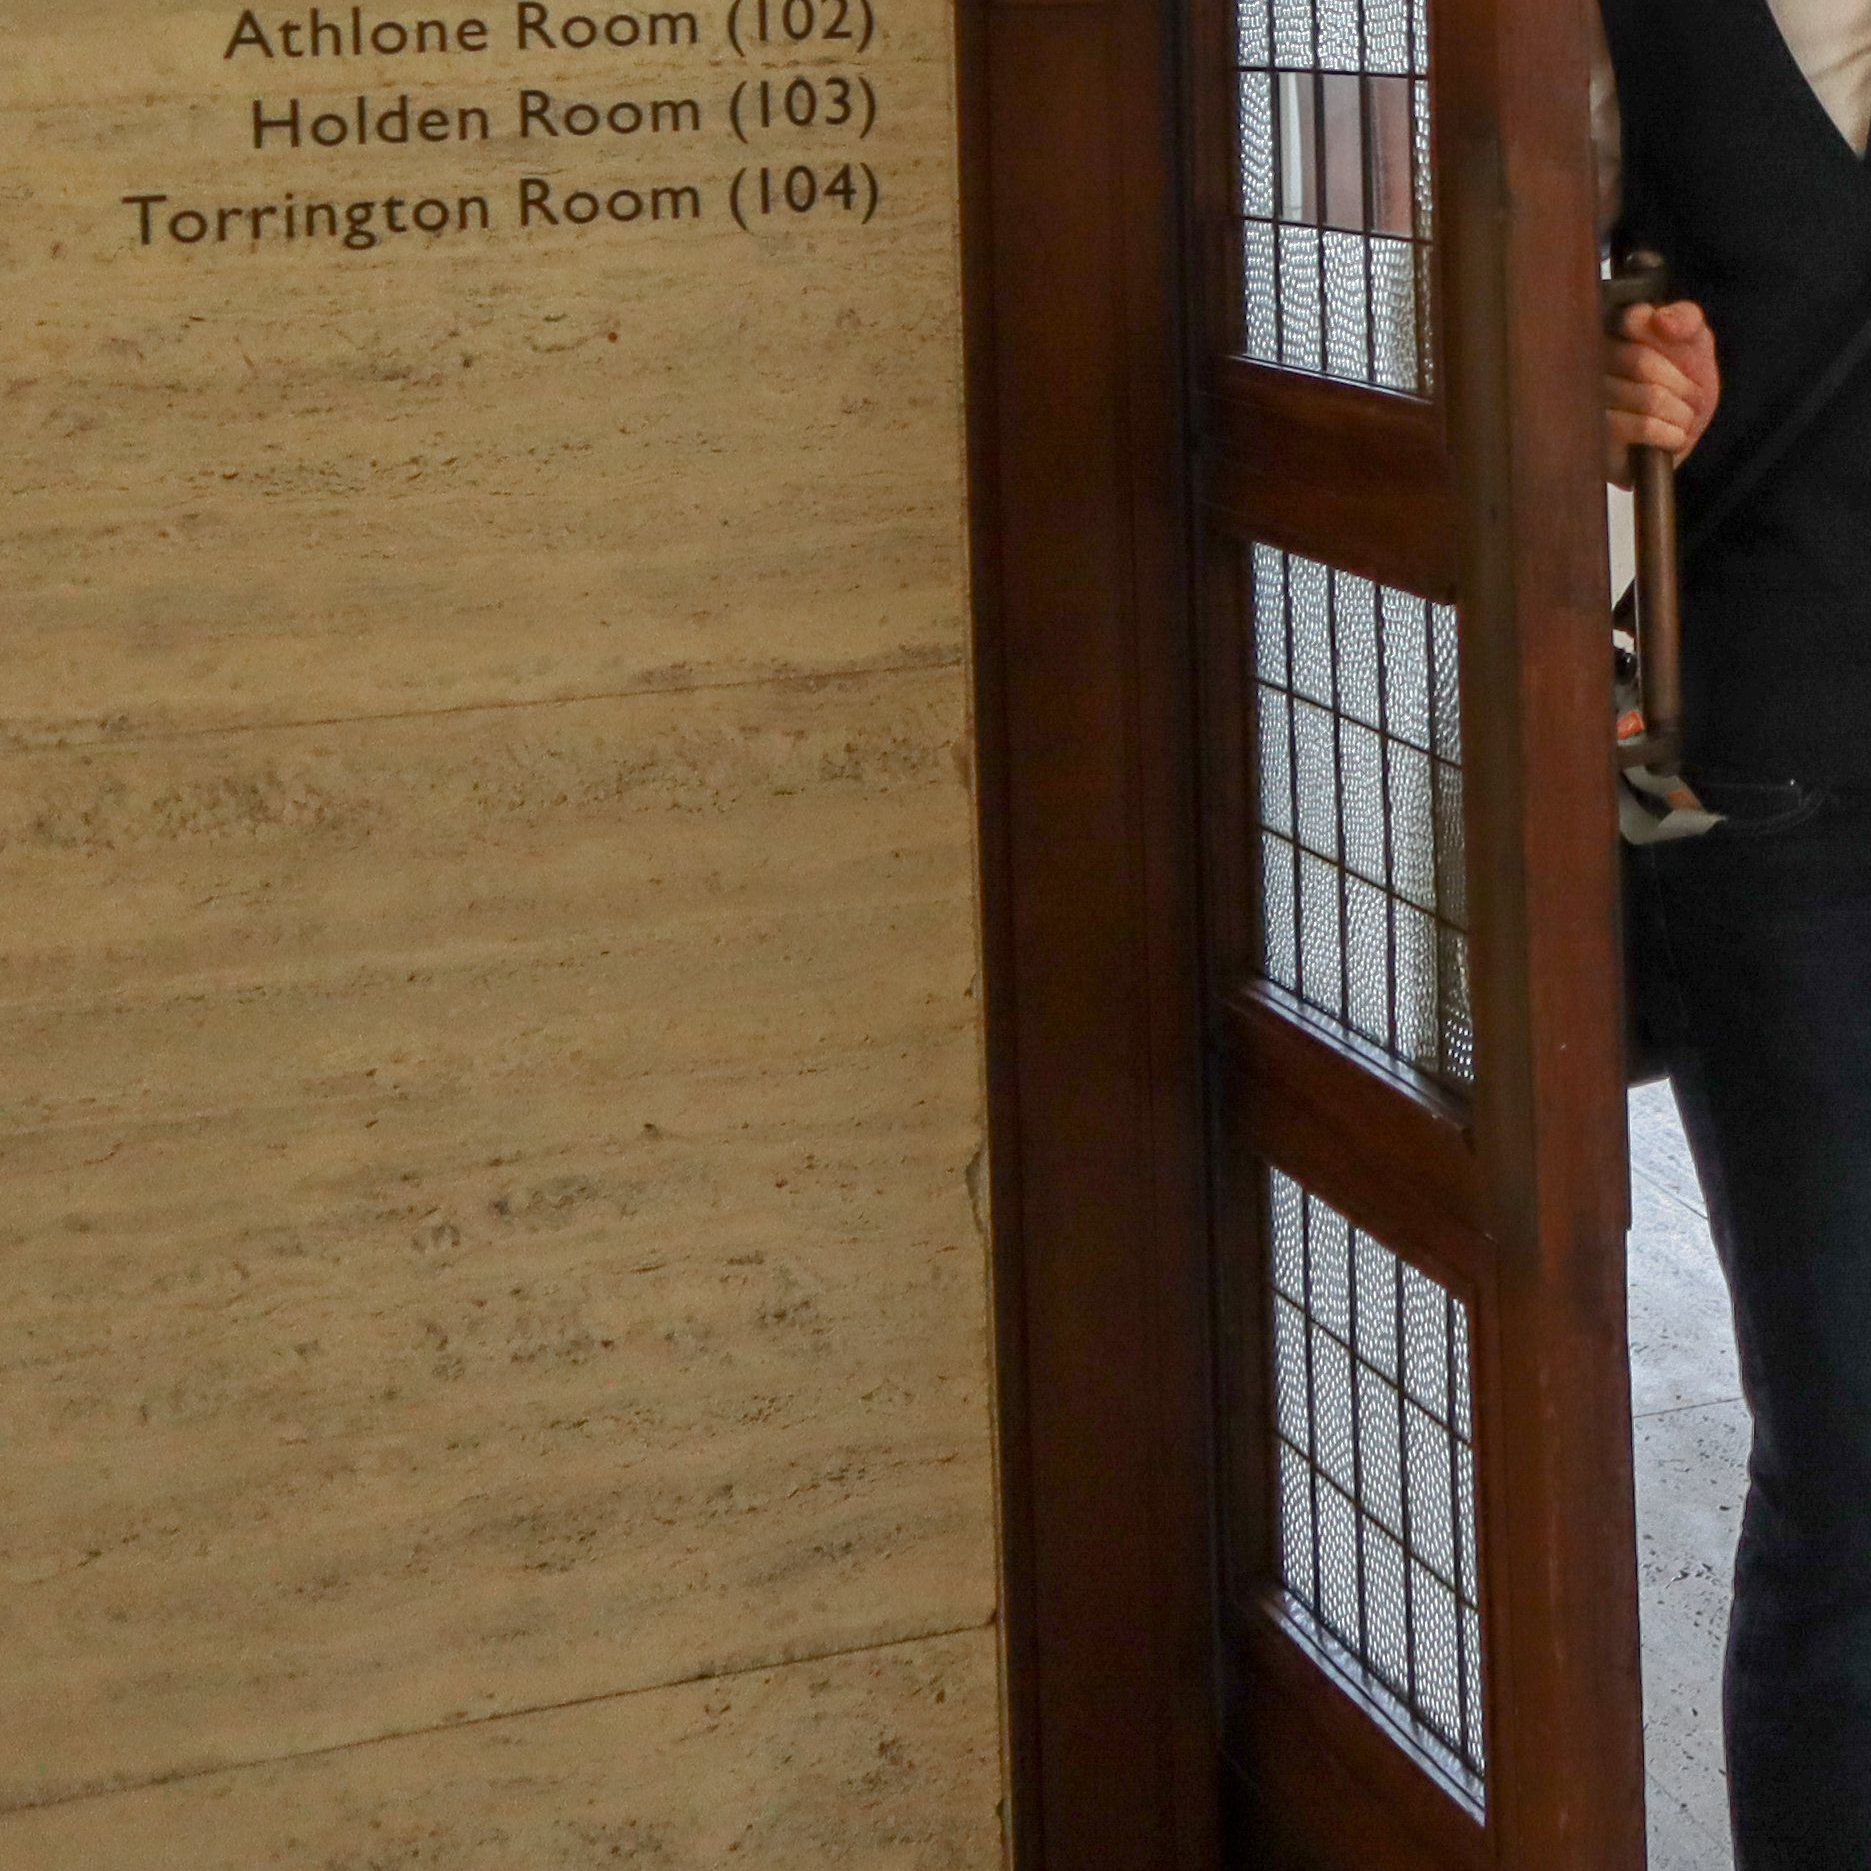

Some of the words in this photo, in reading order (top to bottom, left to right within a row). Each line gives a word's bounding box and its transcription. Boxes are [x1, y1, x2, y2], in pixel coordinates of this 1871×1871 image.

[224, 5, 489, 60] Athlone
[517, 0, 699, 50] Room
[252, 94, 490, 150] Holden
[519, 89, 701, 139] Room
[729, 75, 878, 144] (103)
[122, 193, 489, 251] Torrington
[519, 177, 701, 227] Room
[729, 162, 881, 231] (104)
